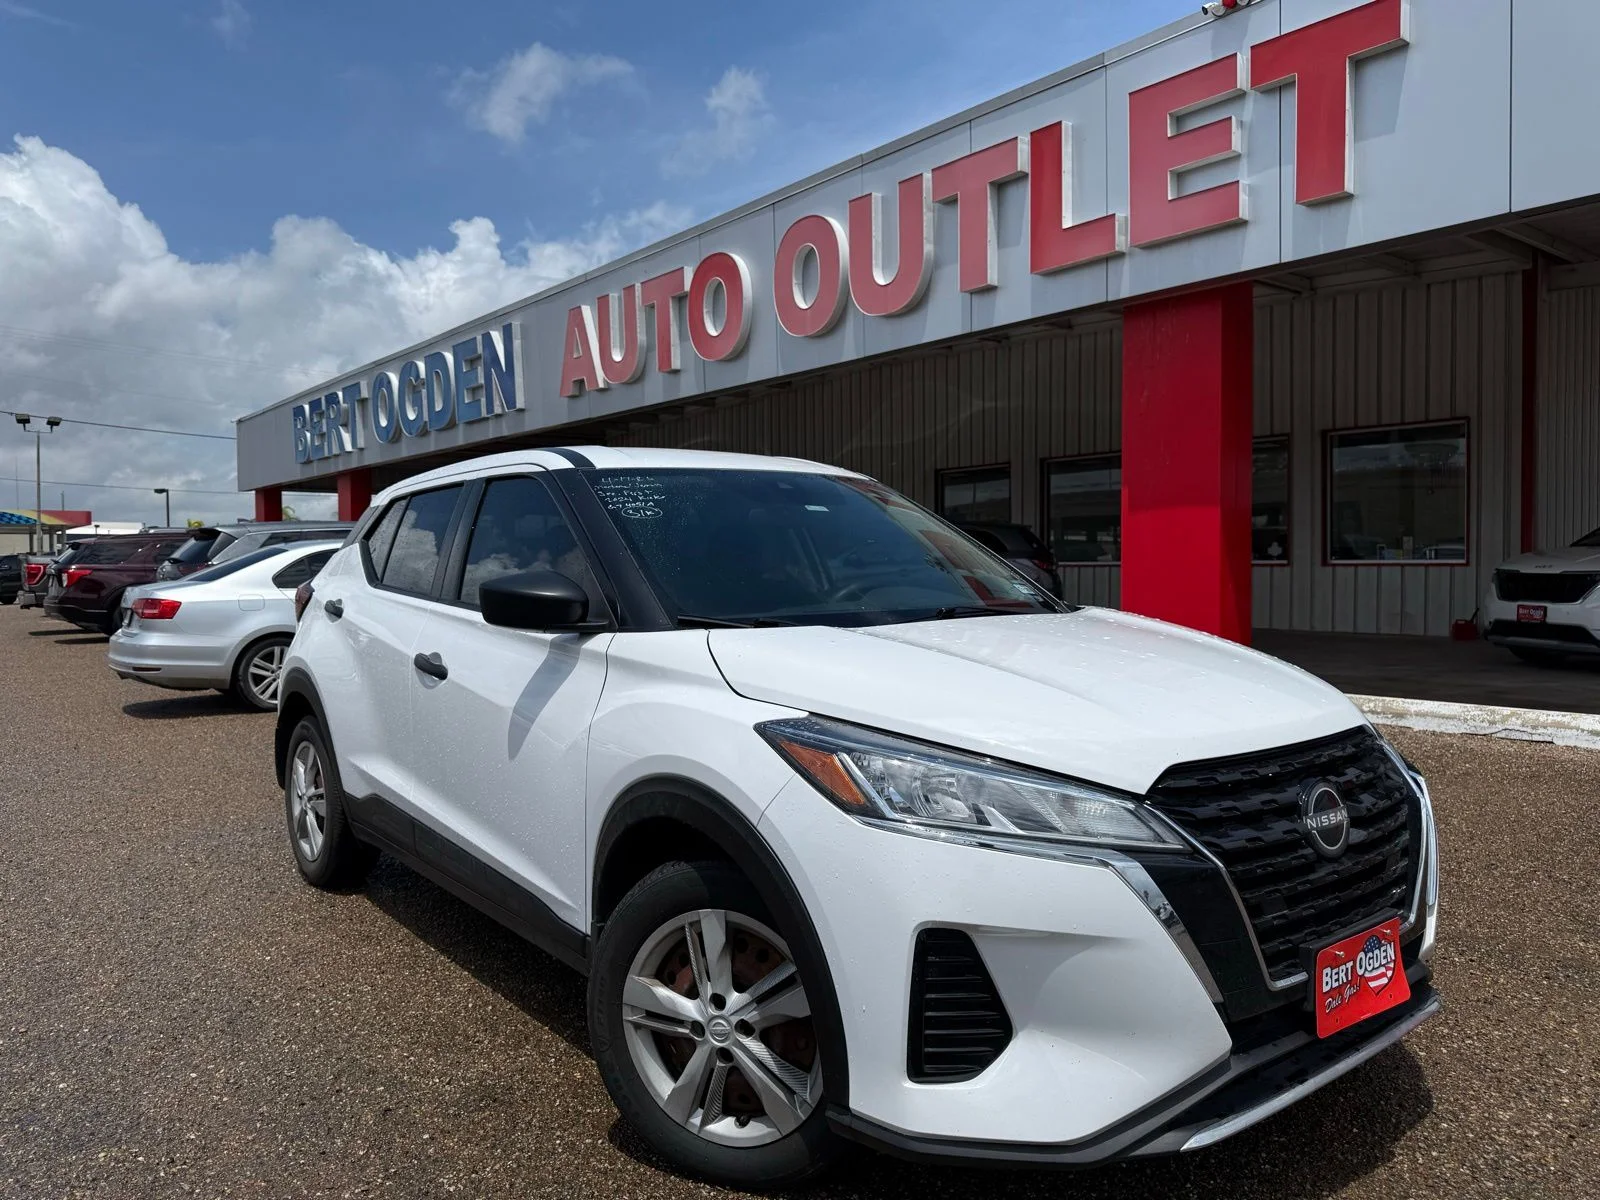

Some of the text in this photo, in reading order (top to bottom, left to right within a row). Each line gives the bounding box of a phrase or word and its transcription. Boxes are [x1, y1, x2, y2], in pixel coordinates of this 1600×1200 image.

[293, 0, 1409, 464] BERT OGDEN AUTO OUTLET
[1307, 807, 1348, 829] NISSAN
[1322, 942, 1395, 993] BERT OGDEN
